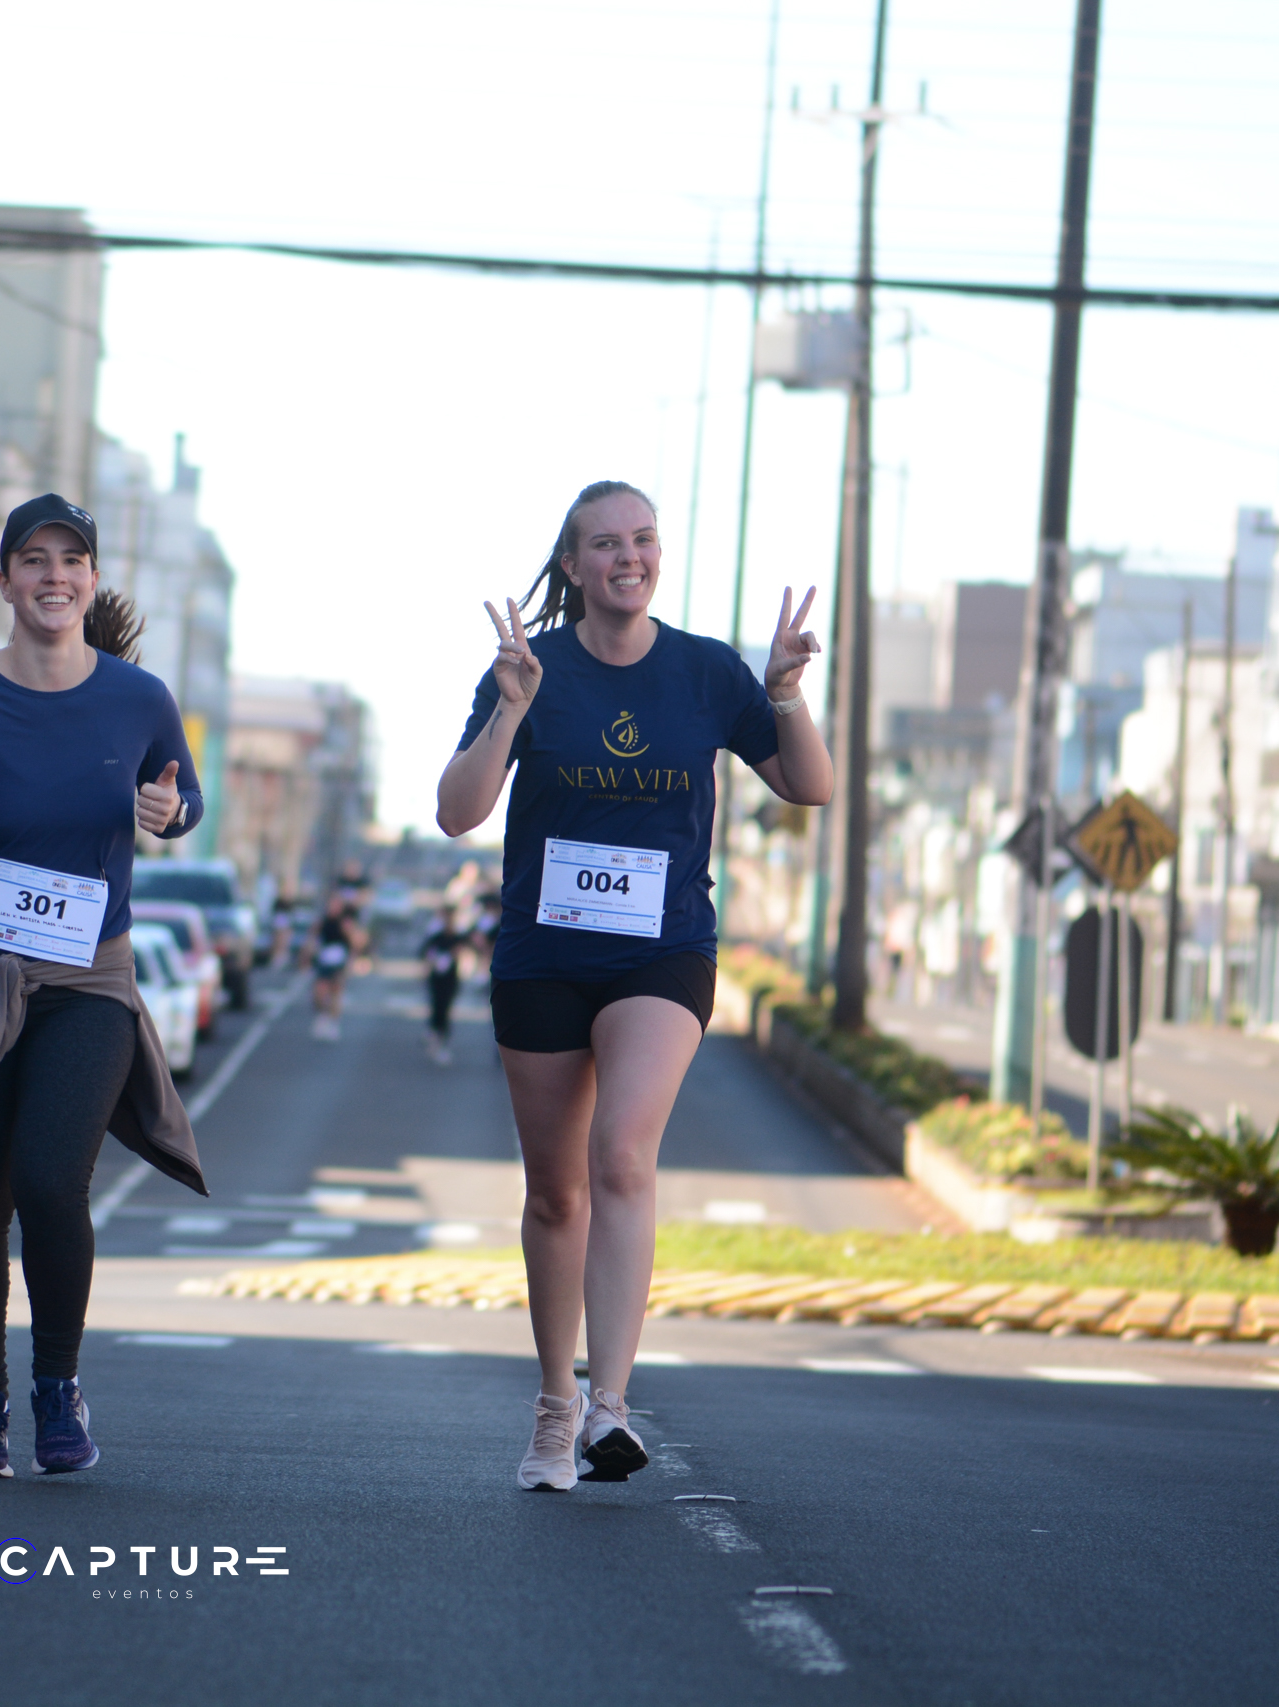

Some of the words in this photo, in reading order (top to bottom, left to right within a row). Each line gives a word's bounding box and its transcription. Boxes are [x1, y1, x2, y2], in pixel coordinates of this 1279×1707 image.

[558, 766, 625, 788] NEW
[633, 768, 689, 791] VITA
[576, 869, 630, 895] 004
[15, 890, 67, 920] 301
